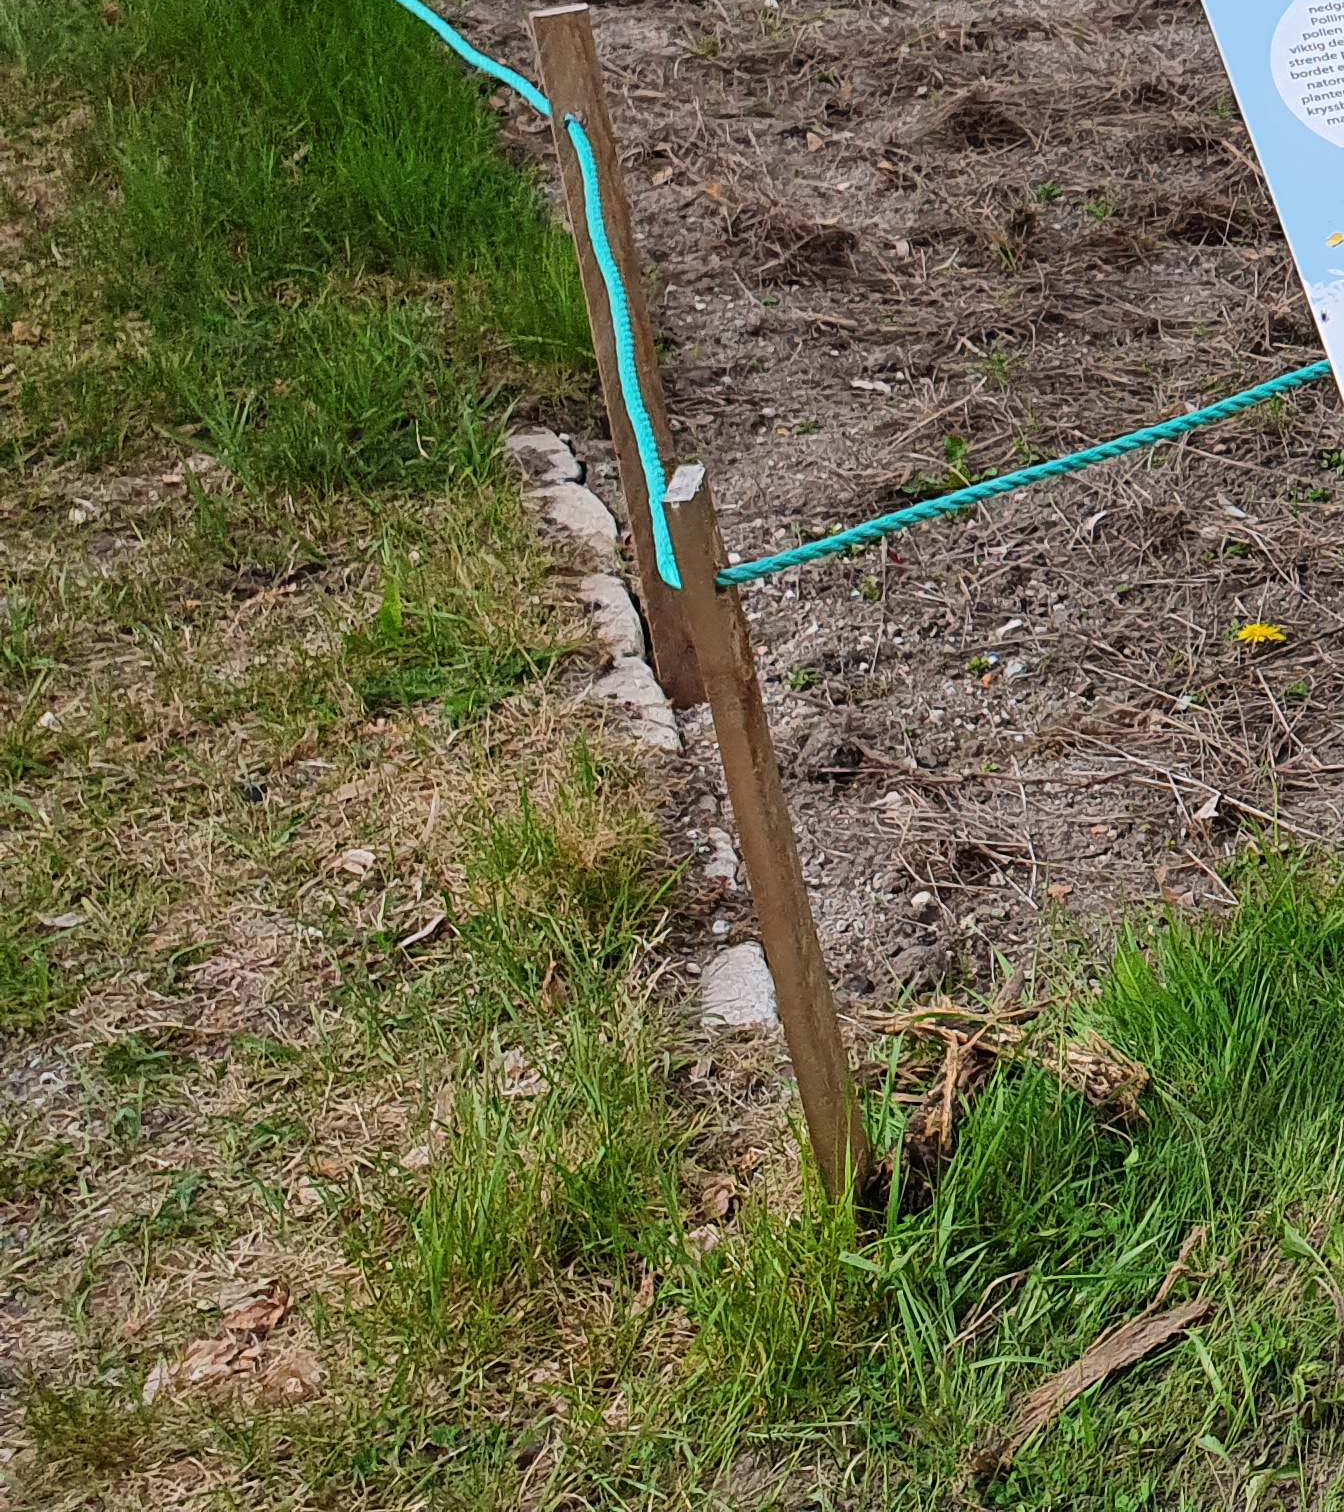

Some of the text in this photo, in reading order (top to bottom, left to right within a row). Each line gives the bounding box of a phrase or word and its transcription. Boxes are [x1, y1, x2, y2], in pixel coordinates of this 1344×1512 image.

[1302, 27, 1343, 41] pollen
[1288, 42, 1325, 54] viktig
[1288, 52, 1337, 67] strende
[1289, 65, 1335, 79] bordet
